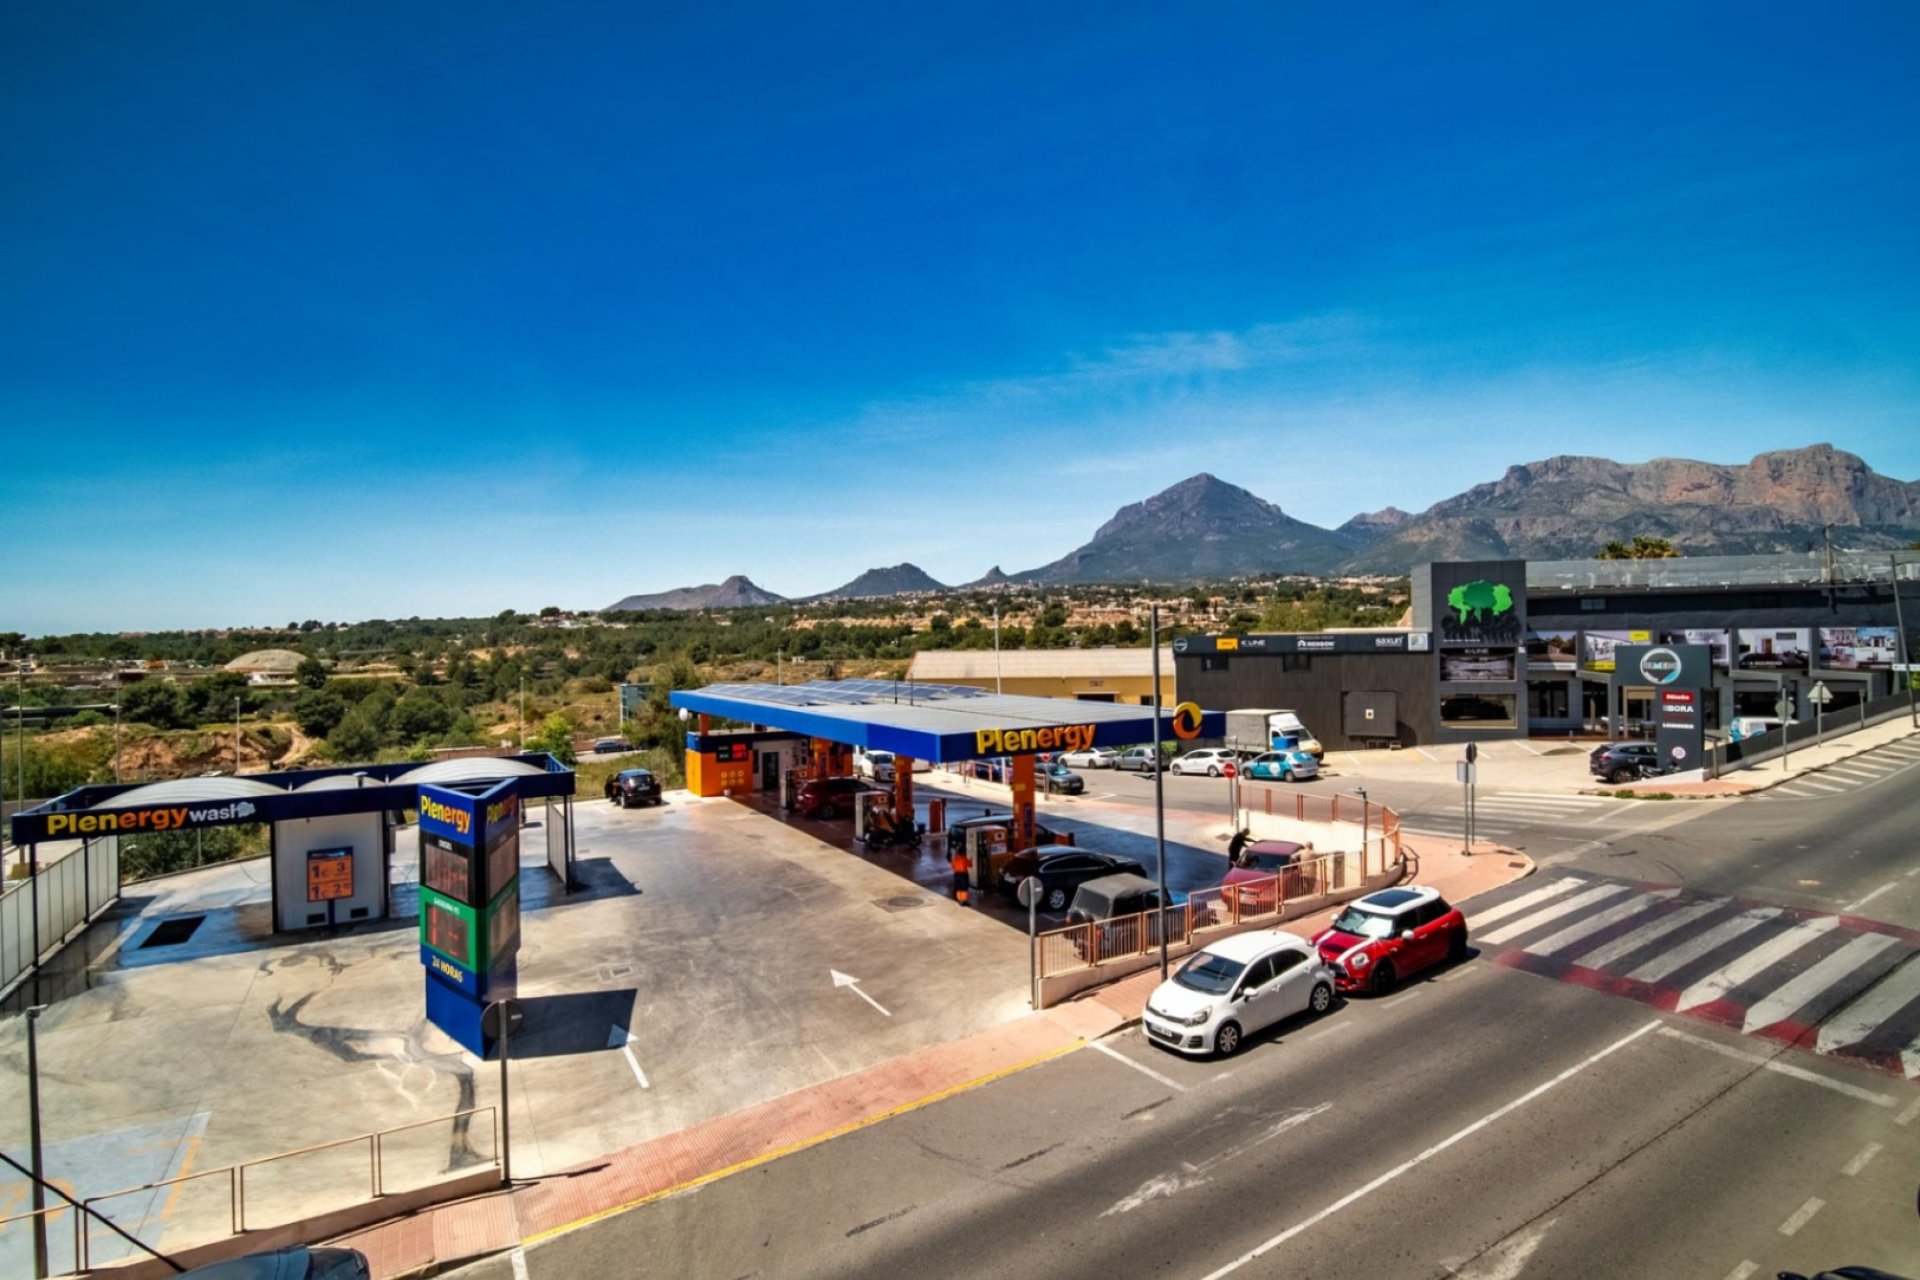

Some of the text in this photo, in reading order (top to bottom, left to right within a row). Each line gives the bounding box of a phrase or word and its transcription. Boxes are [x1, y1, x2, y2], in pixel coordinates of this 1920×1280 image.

[1667, 704, 1694, 713] BORA
[976, 724, 1096, 755] Plenergy
[47, 806, 189, 836] Plenergy
[421, 795, 471, 834] Plenergy
